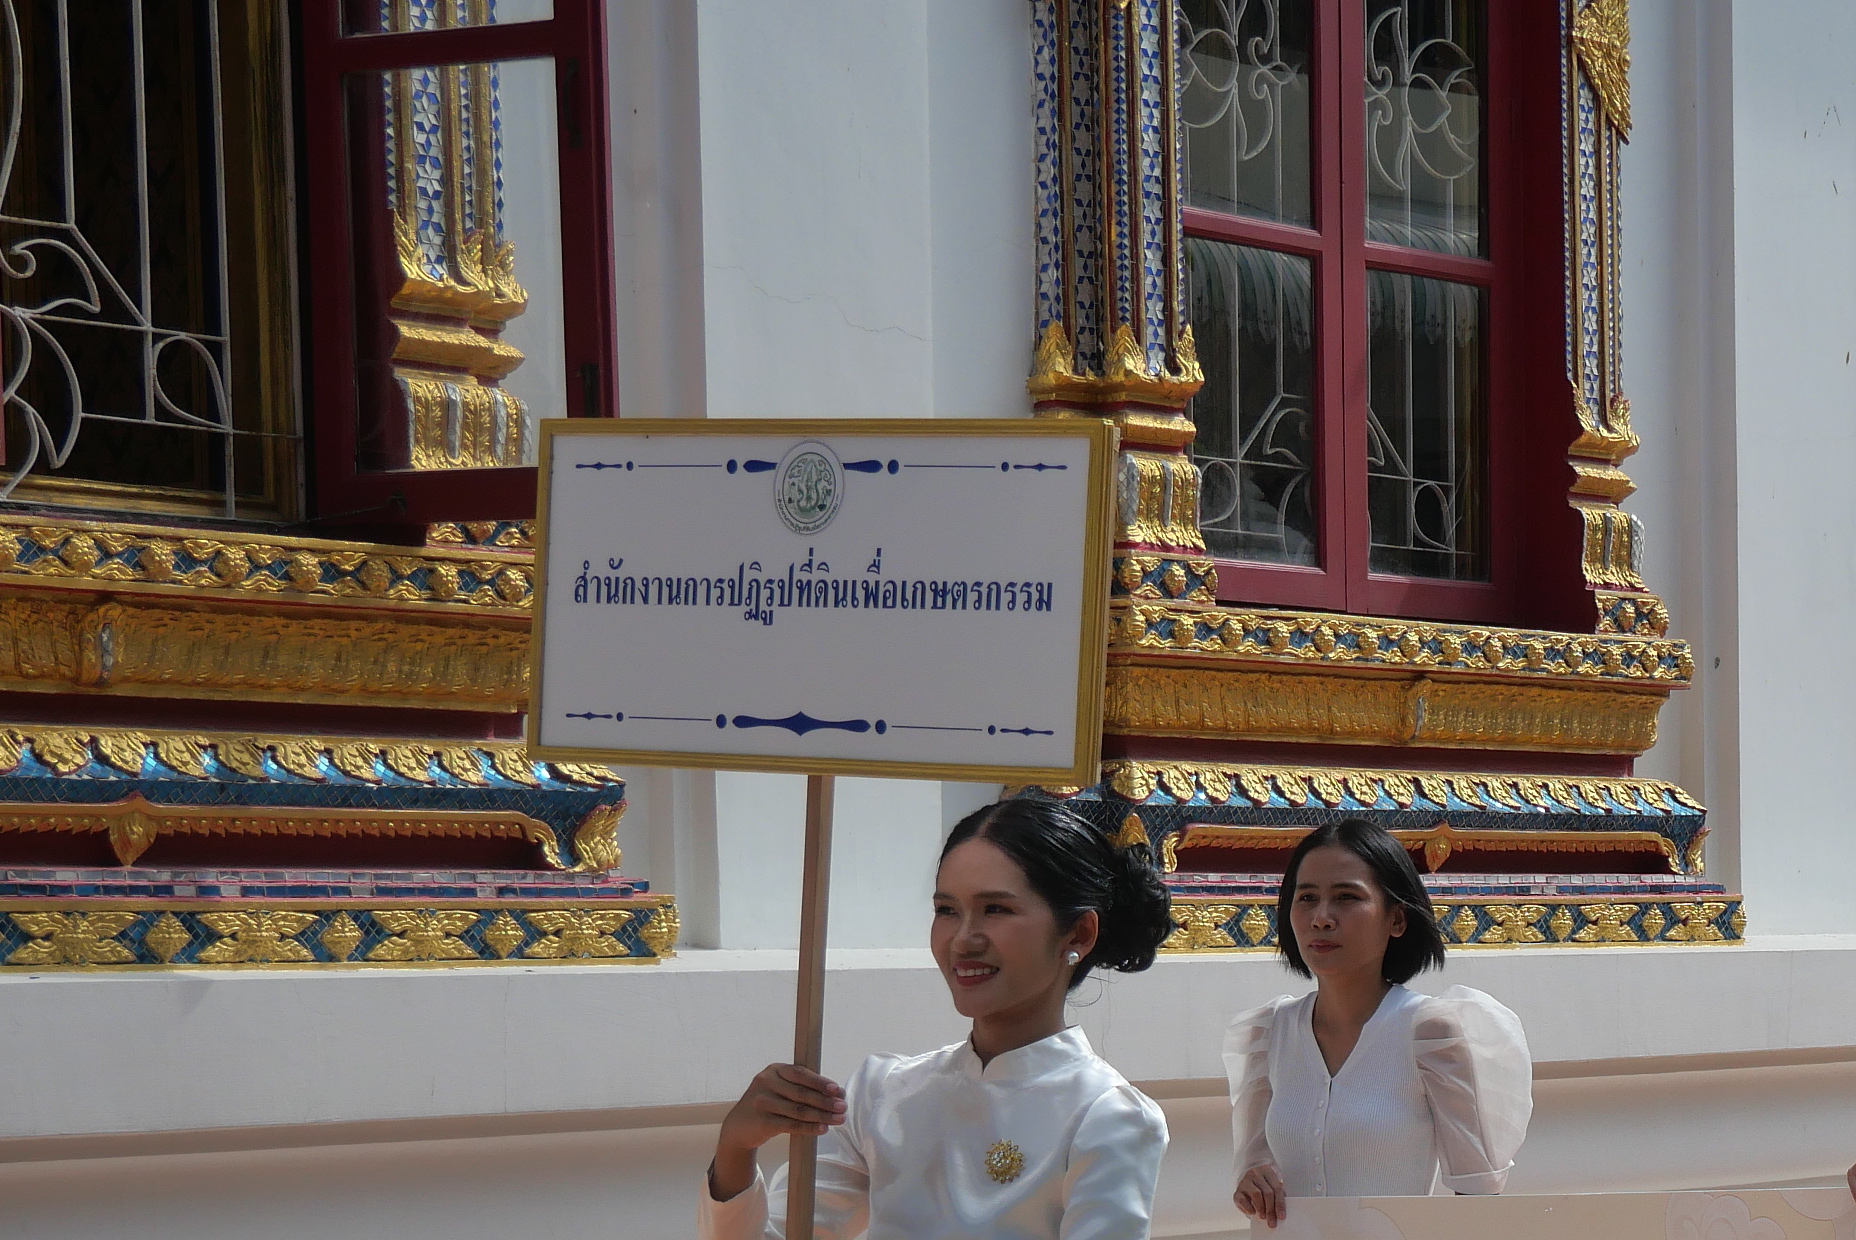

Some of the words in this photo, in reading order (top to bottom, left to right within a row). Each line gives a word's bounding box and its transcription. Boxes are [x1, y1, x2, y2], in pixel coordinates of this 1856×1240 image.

[573, 547, 1054, 626] สำนักงานการปฏิรูปที่ดินเพื่อเกษตรกรรม
